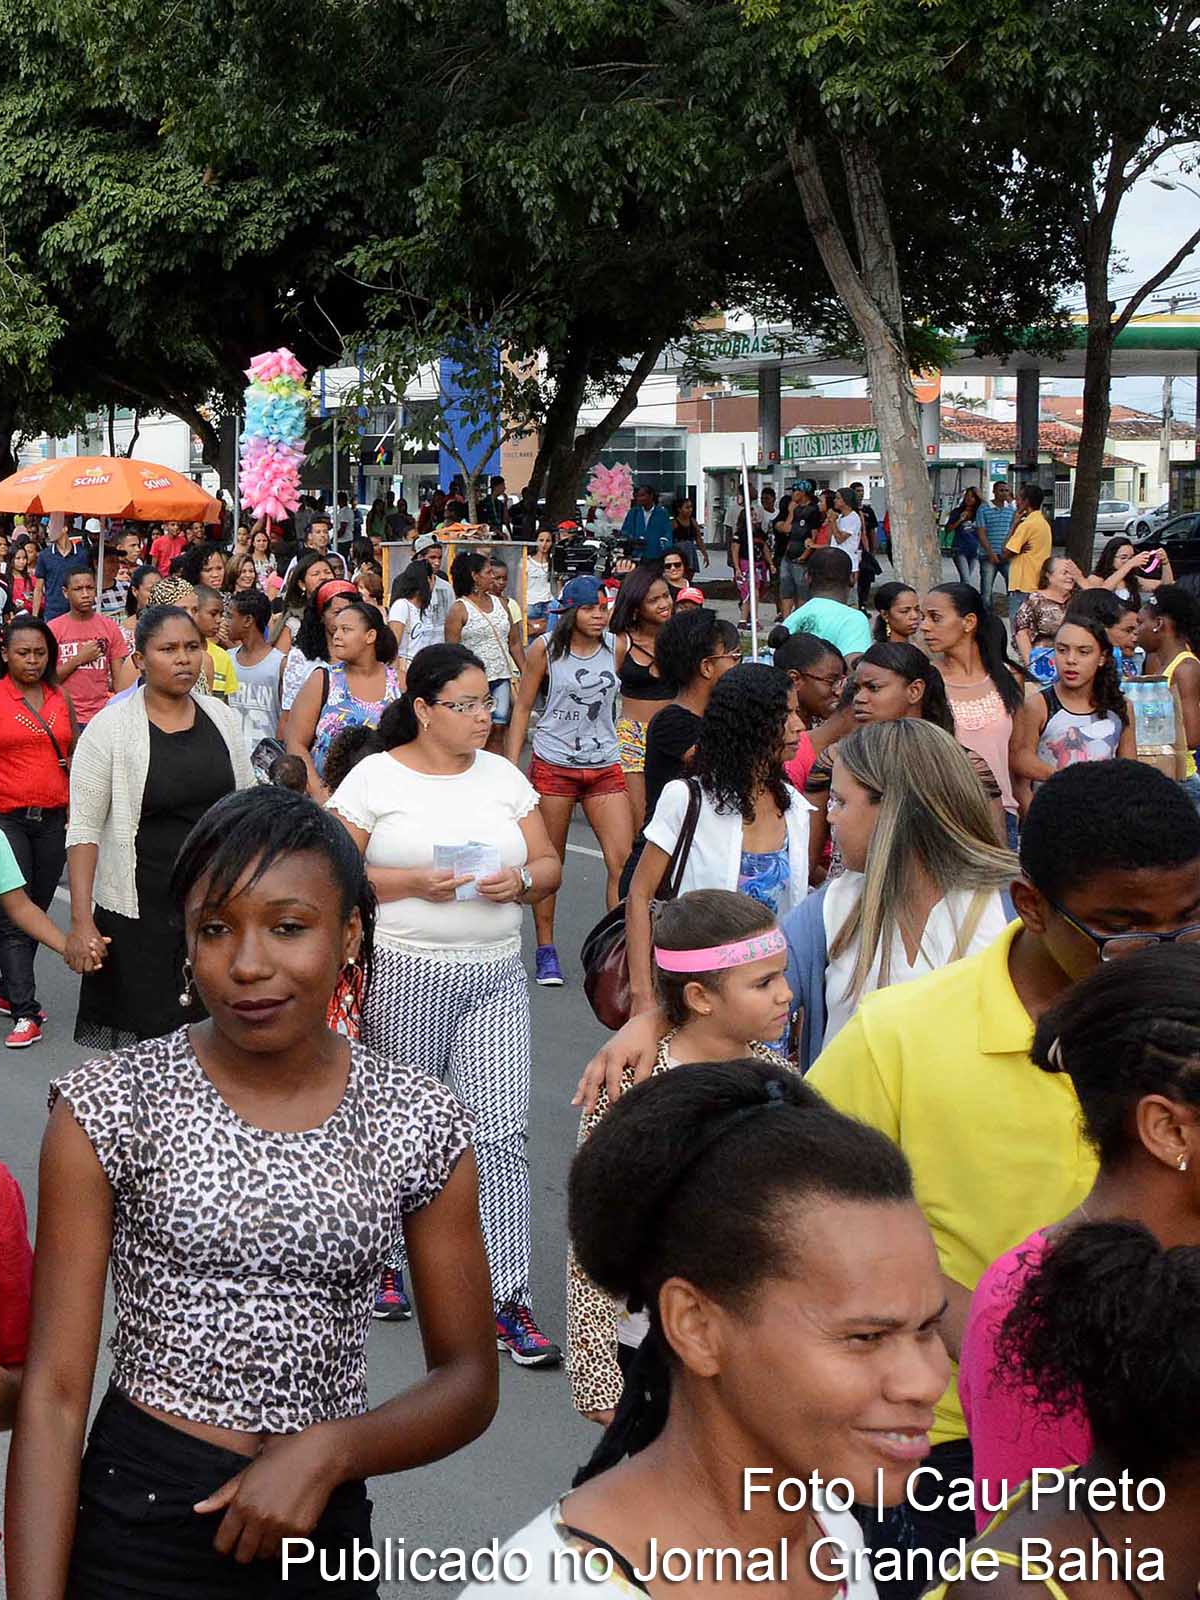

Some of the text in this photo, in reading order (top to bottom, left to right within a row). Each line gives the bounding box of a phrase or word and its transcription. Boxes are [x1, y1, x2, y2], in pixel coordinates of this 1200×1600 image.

[692, 335, 770, 356] ETROBRAS
[787, 430, 877, 459] TEMOS DIESEL S10
[73, 475, 110, 487] SCHIN
[143, 478, 171, 490] SCHIN
[553, 709, 580, 720] STAR
